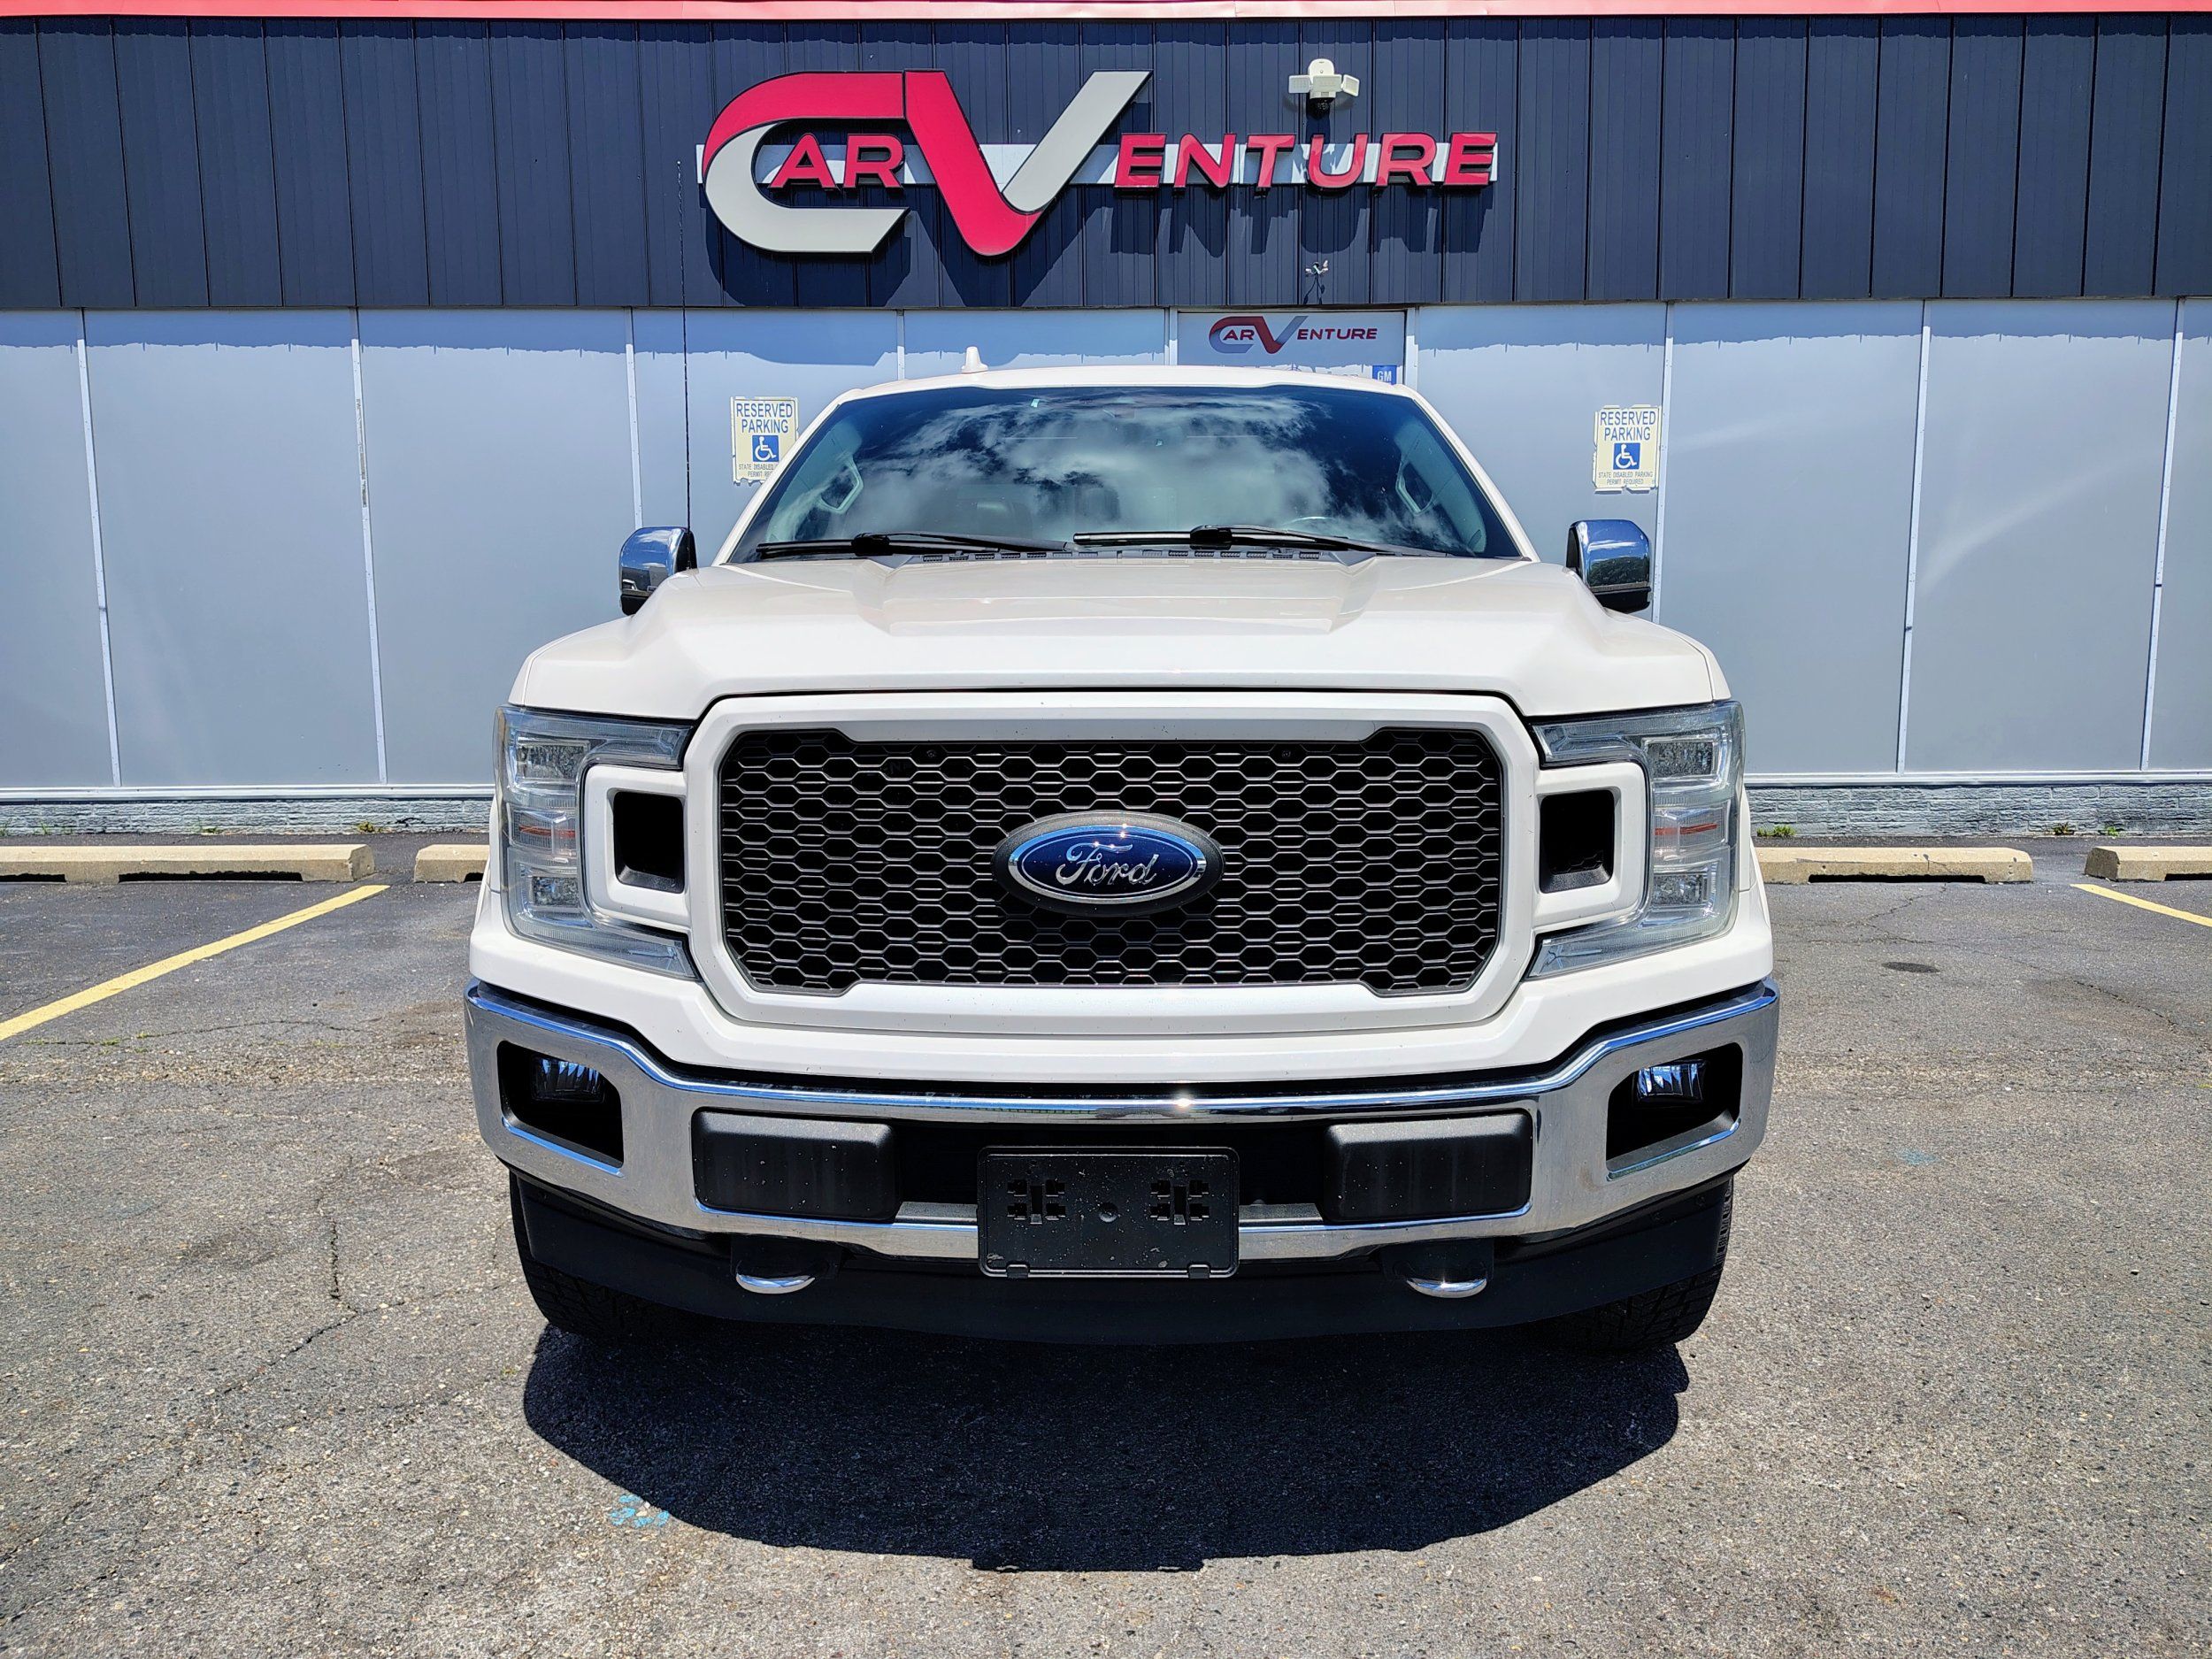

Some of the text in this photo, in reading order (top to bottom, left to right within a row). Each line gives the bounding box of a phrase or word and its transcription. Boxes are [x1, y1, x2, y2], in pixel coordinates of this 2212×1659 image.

[1377, 370, 1392, 382] GM
[736, 403, 793, 418] RESERVED
[1600, 411, 1656, 426] RESERVED
[741, 419, 788, 434] PARKING
[1604, 426, 1651, 441] PARKING
[1055, 842, 1159, 885] Ford
